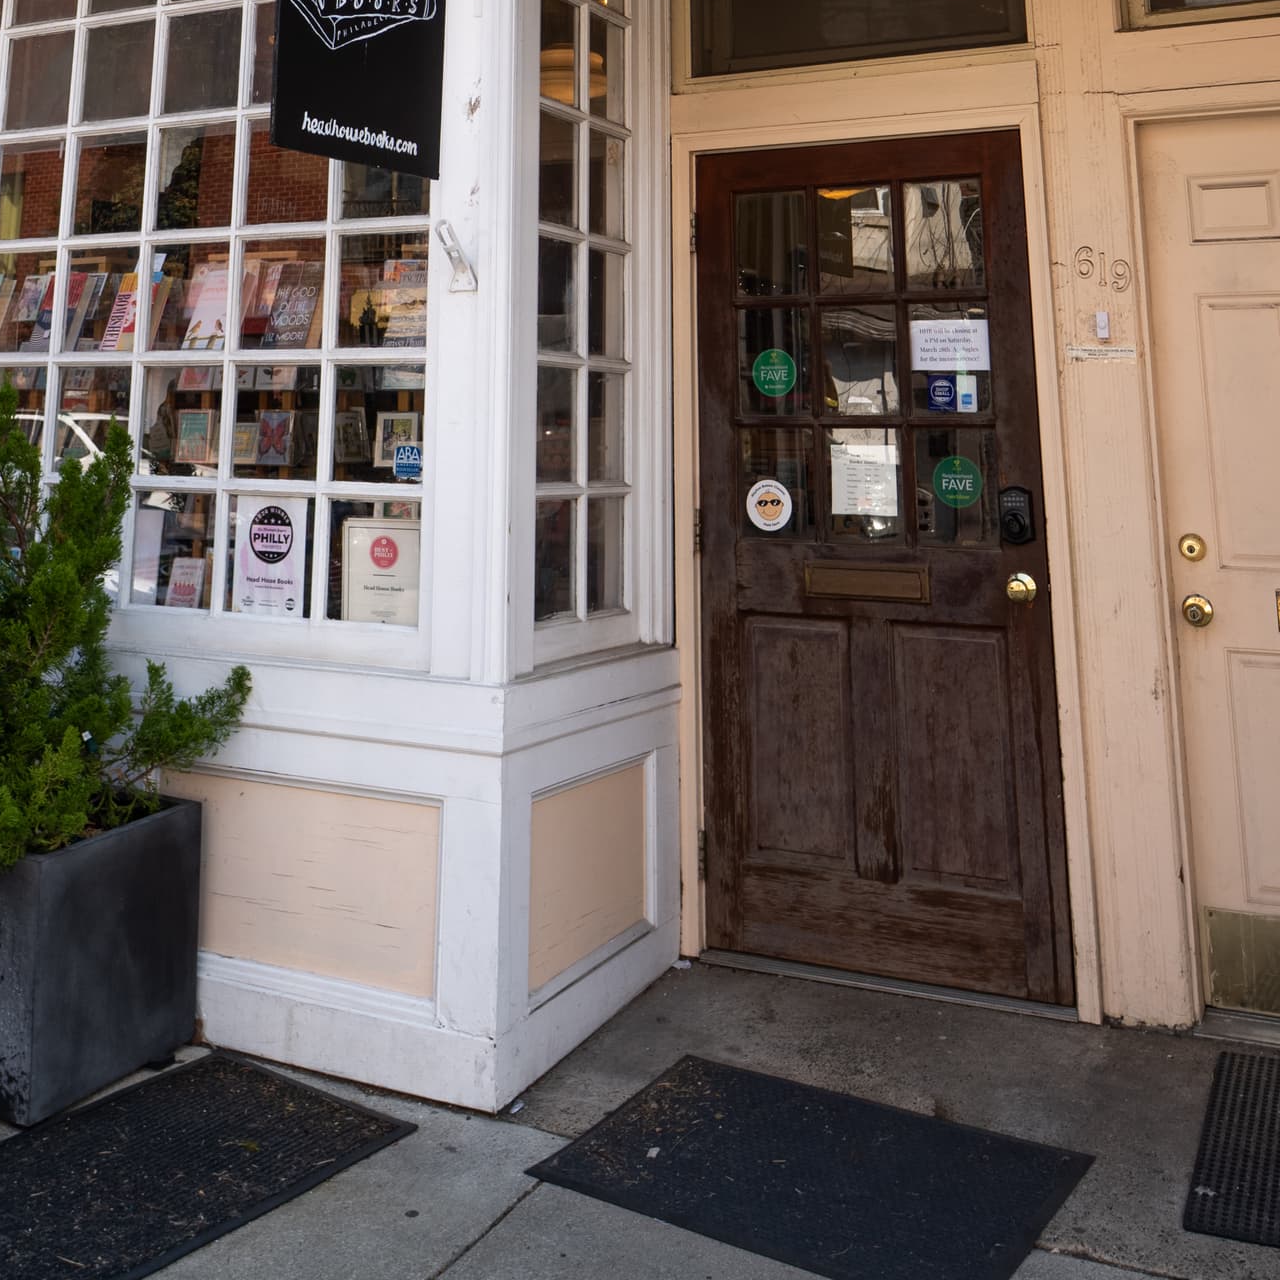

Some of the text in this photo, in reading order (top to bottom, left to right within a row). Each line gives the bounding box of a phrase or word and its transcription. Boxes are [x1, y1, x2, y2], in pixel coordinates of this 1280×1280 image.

[301, 111, 418, 156] headhousebooks.com
[1074, 246, 1132, 293] 619
[291, 286, 316, 297] GOD
[102, 294, 132, 348] BOMBSHELL
[270, 314, 310, 325] WOODS
[760, 370, 789, 381] FAVE
[396, 446, 420, 464] ABA
[942, 479, 974, 491] FAVE
[253, 532, 291, 544] PHILLY
[277, 577, 294, 585] Books
